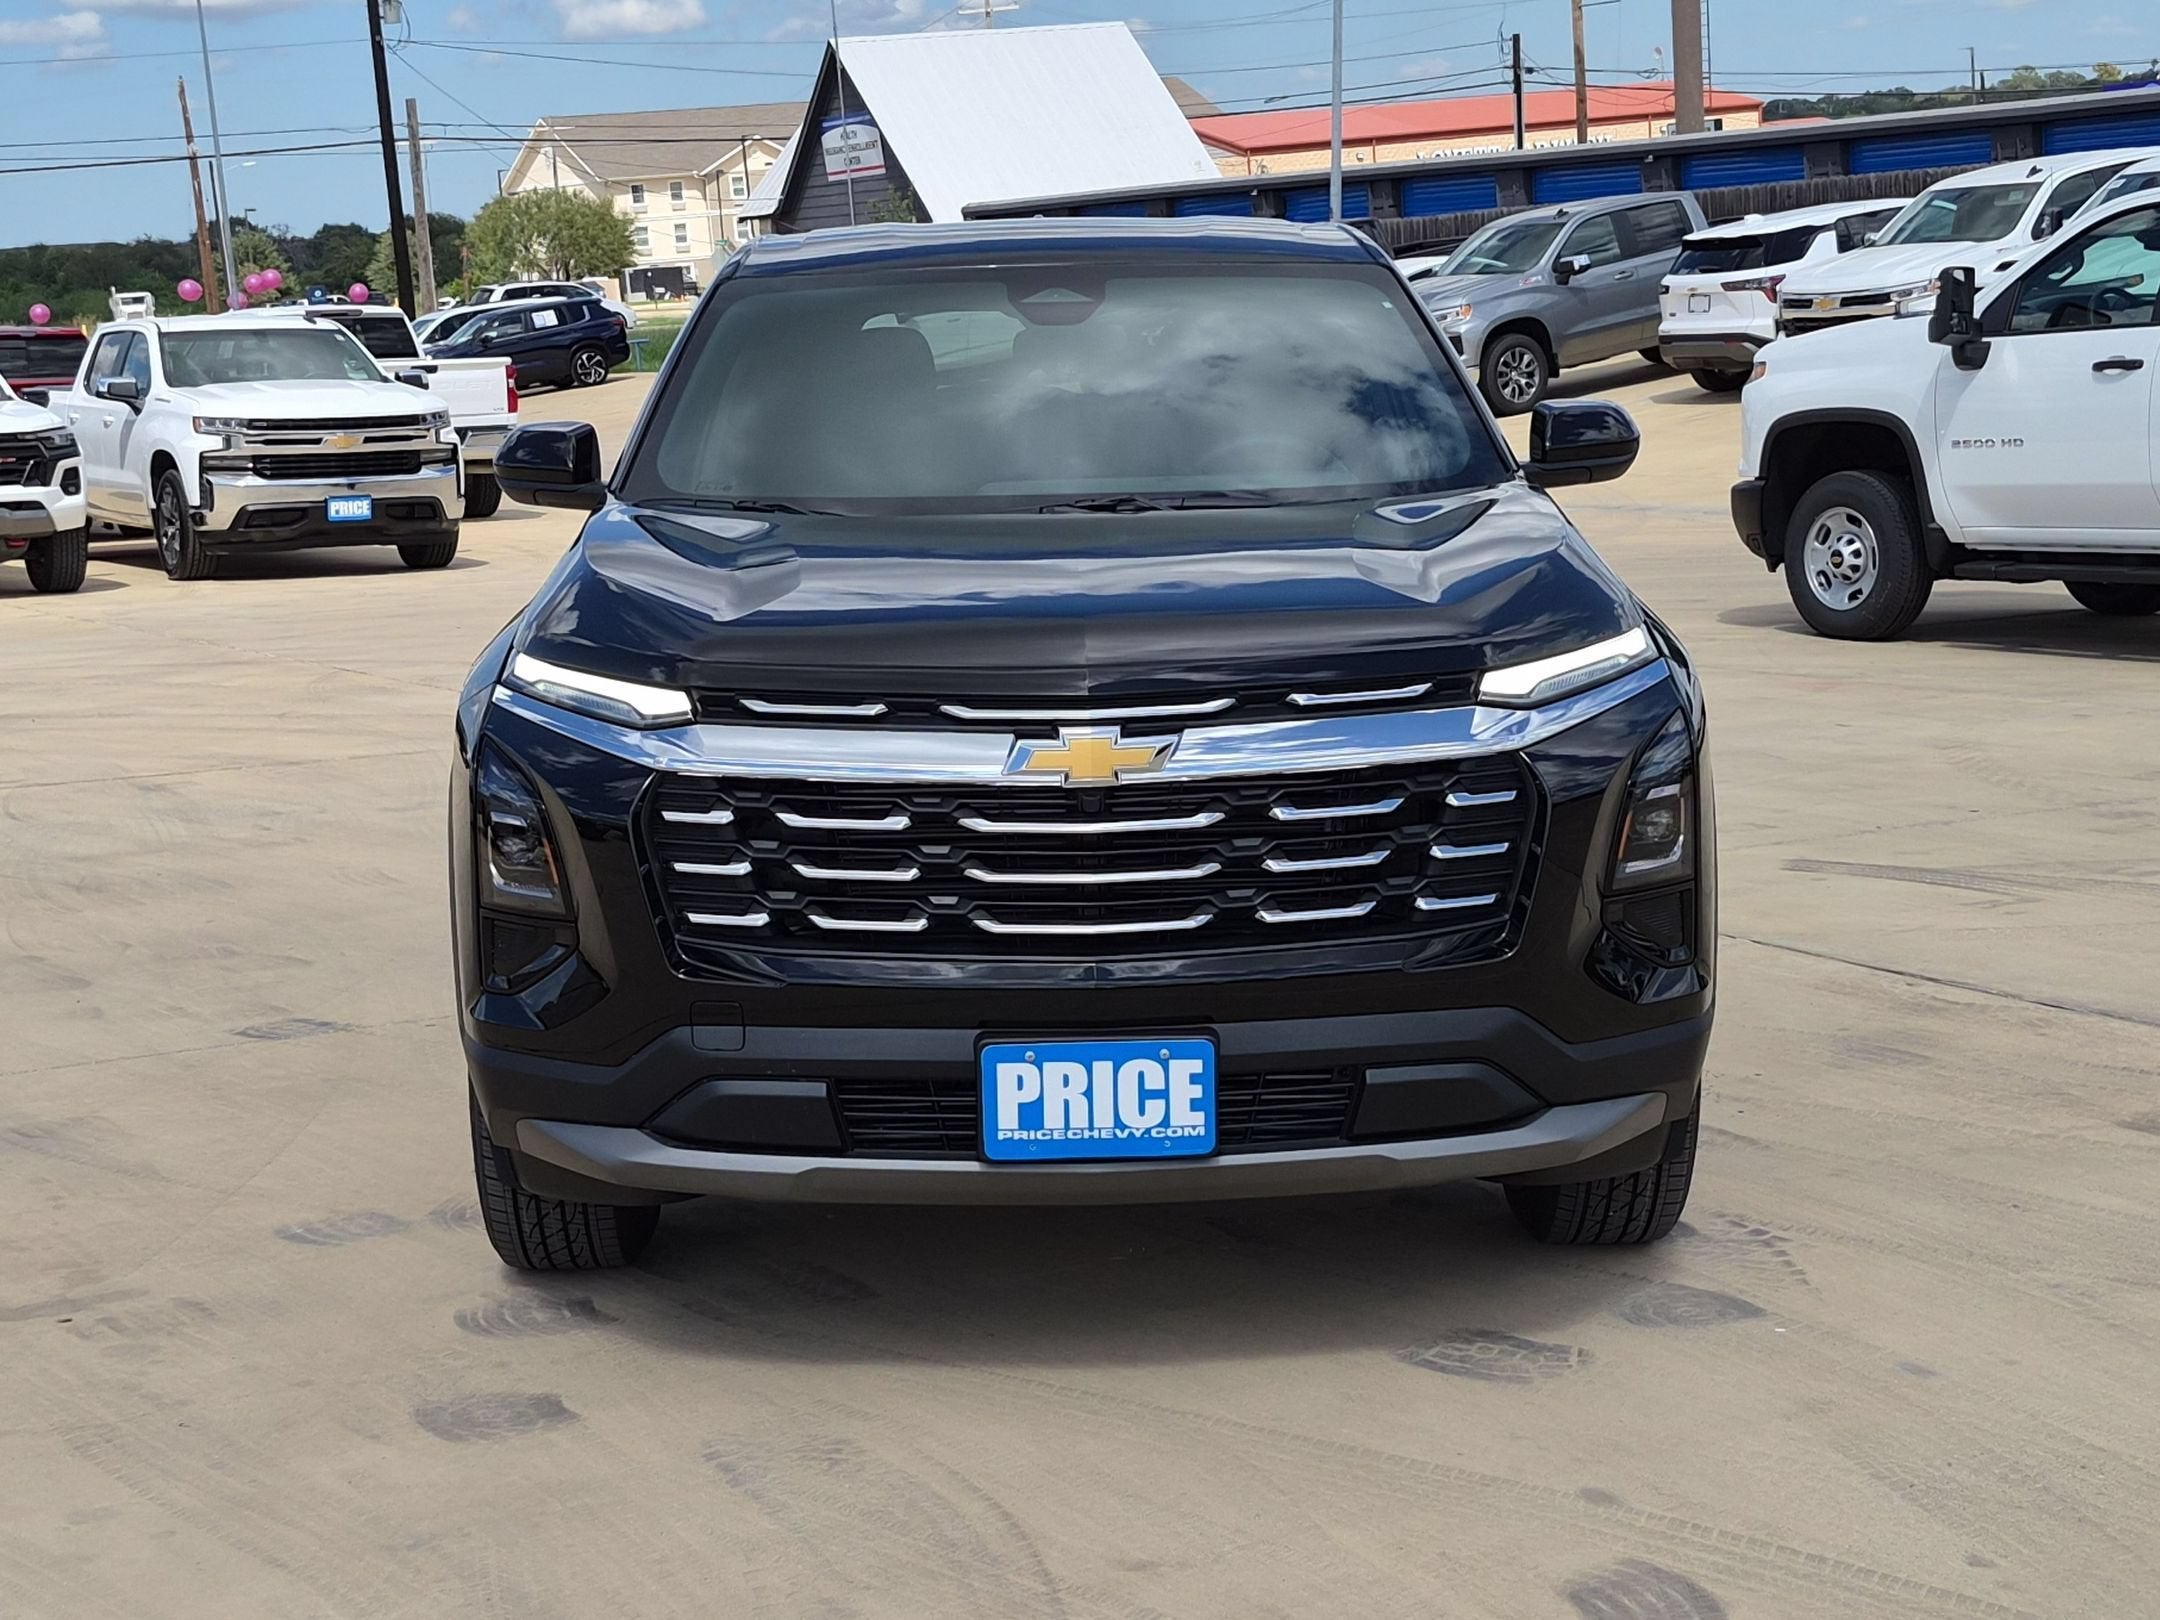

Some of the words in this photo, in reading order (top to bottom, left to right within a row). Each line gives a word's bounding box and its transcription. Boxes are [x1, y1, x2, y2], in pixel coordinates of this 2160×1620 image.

[1951, 439, 1996, 449] 2500
[2001, 438, 2024, 448] HD
[331, 500, 370, 515] PRICE
[996, 1059, 1205, 1129] PRICE
[997, 1126, 1205, 1141] PRICECHEVY.COM
